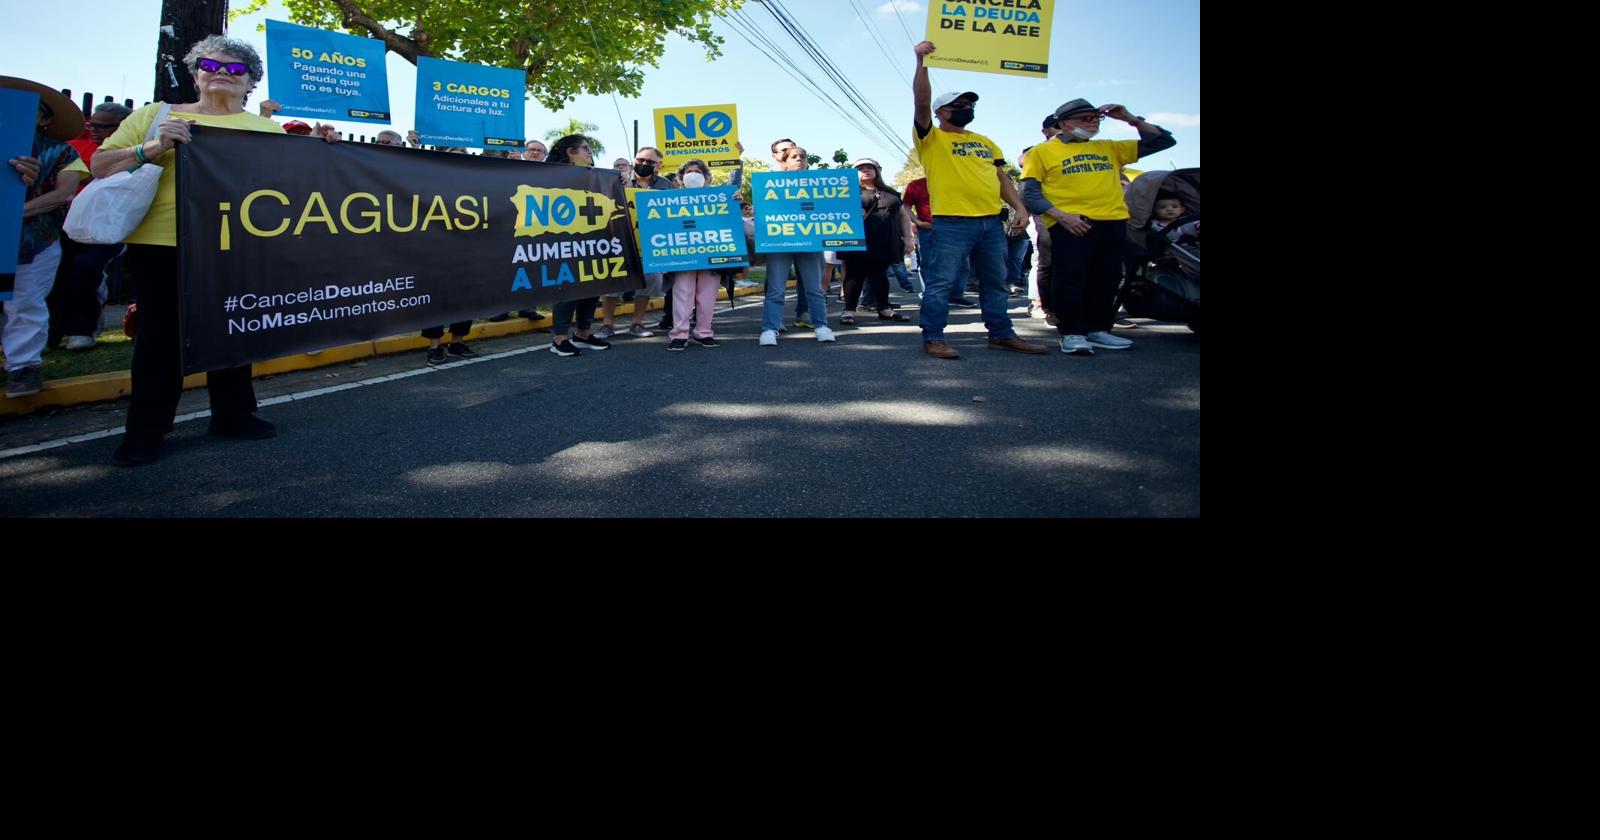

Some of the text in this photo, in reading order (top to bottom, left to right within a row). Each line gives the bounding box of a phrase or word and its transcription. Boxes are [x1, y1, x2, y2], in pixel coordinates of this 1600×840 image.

[945, 0, 1041, 9] CELA
[941, 4, 1040, 23] LA DEUDA
[940, 18, 1040, 37] DE LA AEE
[291, 47, 366, 68] 50 AÑOS
[293, 62, 366, 79] Pagando una
[302, 73, 360, 87] deuda que
[301, 83, 316, 91] no
[335, 86, 361, 96] tuya.
[433, 81, 510, 98] 3 CARGOS
[433, 94, 489, 107] Adicionales
[500, 100, 510, 108] tu
[437, 103, 505, 116] factura de luz.
[666, 147, 730, 156] PENSIONADOS
[764, 187, 850, 200] A LA LUZ
[647, 203, 729, 219] A LA LUZ
[765, 213, 807, 222] MAYOR
[219, 189, 489, 250] ¡CAGUAS!
[767, 222, 854, 236] DE VIDA
[650, 229, 734, 248] CIERRE
[652, 248, 668, 257] DE
[511, 256, 628, 292] A LA LUZ
[224, 276, 415, 312] #CancelaDeudaAEE
[228, 293, 431, 335] NoMasAumentos.com
